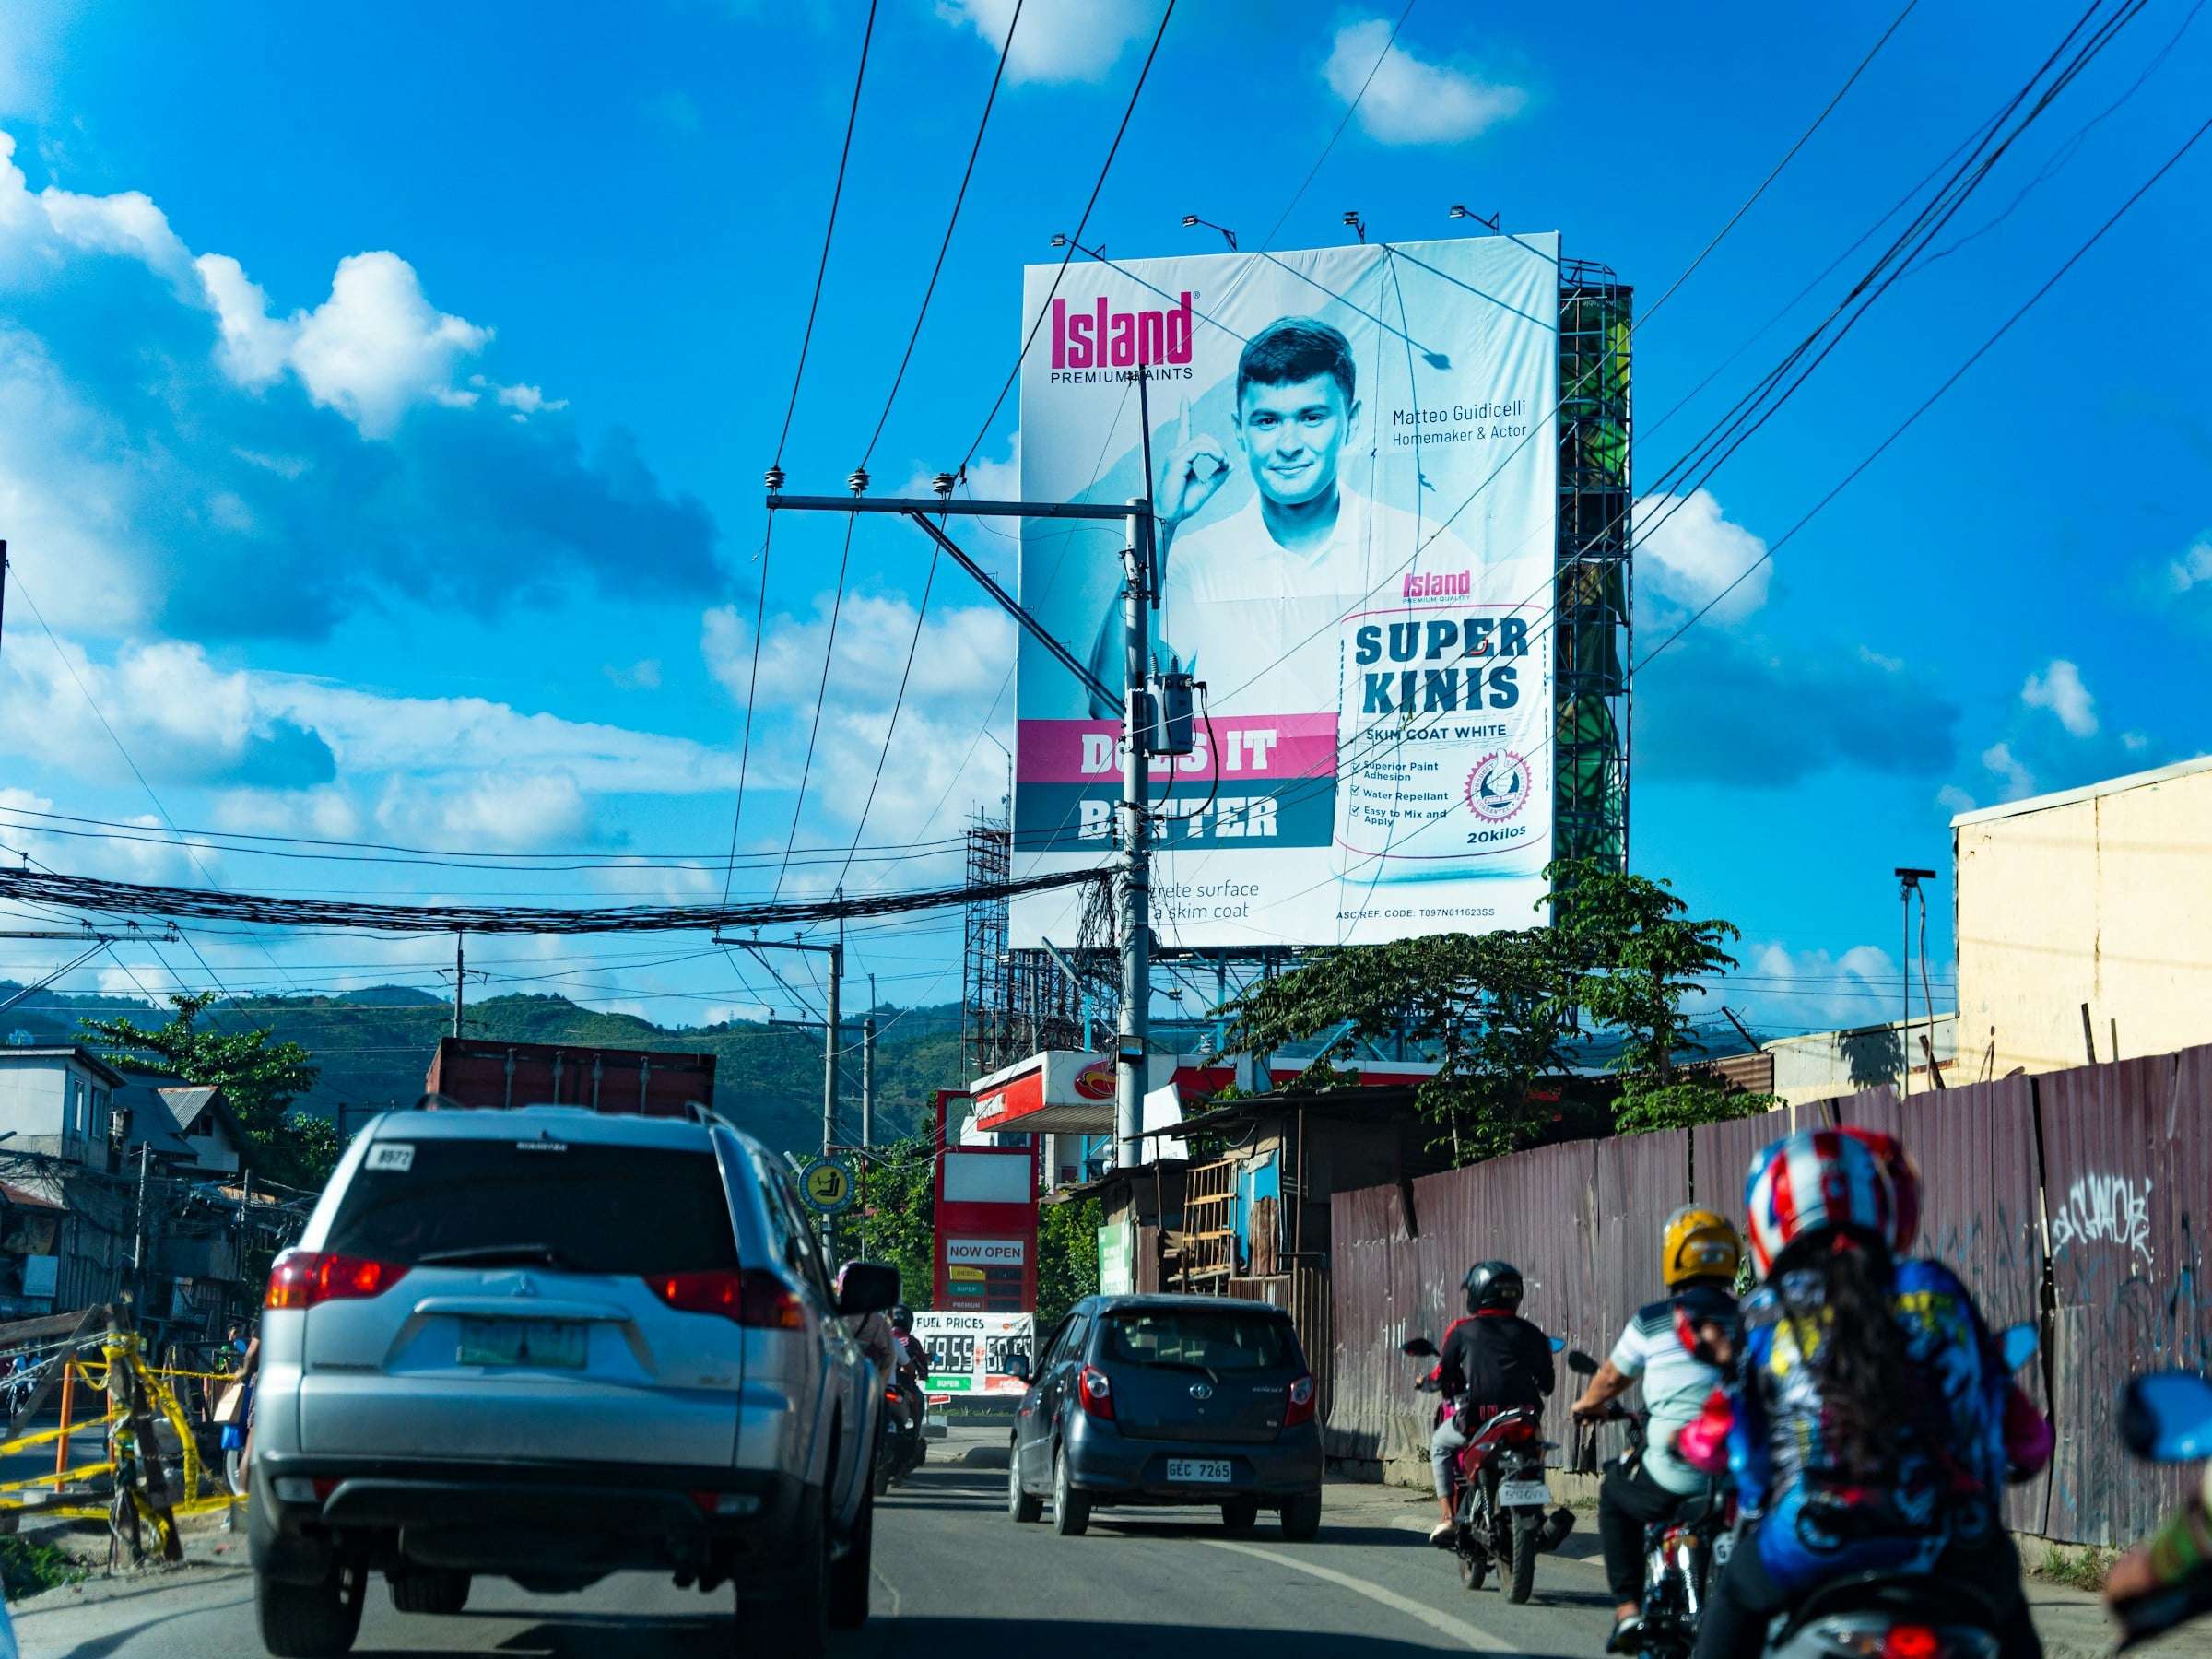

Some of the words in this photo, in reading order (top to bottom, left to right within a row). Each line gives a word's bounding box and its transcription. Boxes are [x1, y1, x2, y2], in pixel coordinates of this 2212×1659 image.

[1052, 291, 1193, 369] Island
[1051, 371, 1127, 384] PREMIUM
[1139, 368, 1193, 381] AINTS
[1394, 409, 1448, 426] Matteo
[1453, 399, 1526, 421] Guidicelli
[1393, 429, 1473, 446] Homemaker
[1477, 426, 1486, 440] &
[1490, 425, 1527, 439] Actor
[1403, 570, 1471, 597] Island
[1356, 618, 1529, 665] SUPER
[1362, 666, 1520, 714] KINIS
[1366, 729, 1401, 741] SKIM
[1406, 727, 1449, 740] COAT
[1454, 724, 1507, 738] WHITE
[1226, 729, 1277, 771] IT
[1363, 760, 1406, 771] Superior
[1410, 762, 1439, 771] Paint
[1363, 771, 1411, 782] Adhesion
[1363, 789, 1393, 800] Water
[1395, 792, 1449, 802] Repellant
[1364, 806, 1386, 818] Easy
[1389, 809, 1401, 818] to
[1404, 810, 1422, 818] Mix
[1426, 809, 1447, 818] and
[1364, 818, 1394, 827] Apply
[1467, 826, 1527, 844] 20kilos
[1196, 879, 1260, 898] surface
[1168, 903, 1209, 919] skim
[1215, 902, 1249, 918] coat
[1336, 911, 1358, 920] ASC
[1384, 909, 1416, 918] CODE:
[950, 1246, 981, 1257] NOW
[984, 1246, 1020, 1258] OPEN
[916, 1317, 941, 1327] FUEL
[946, 1318, 984, 1329] PRICES
[1169, 1463, 1192, 1477] GEC
